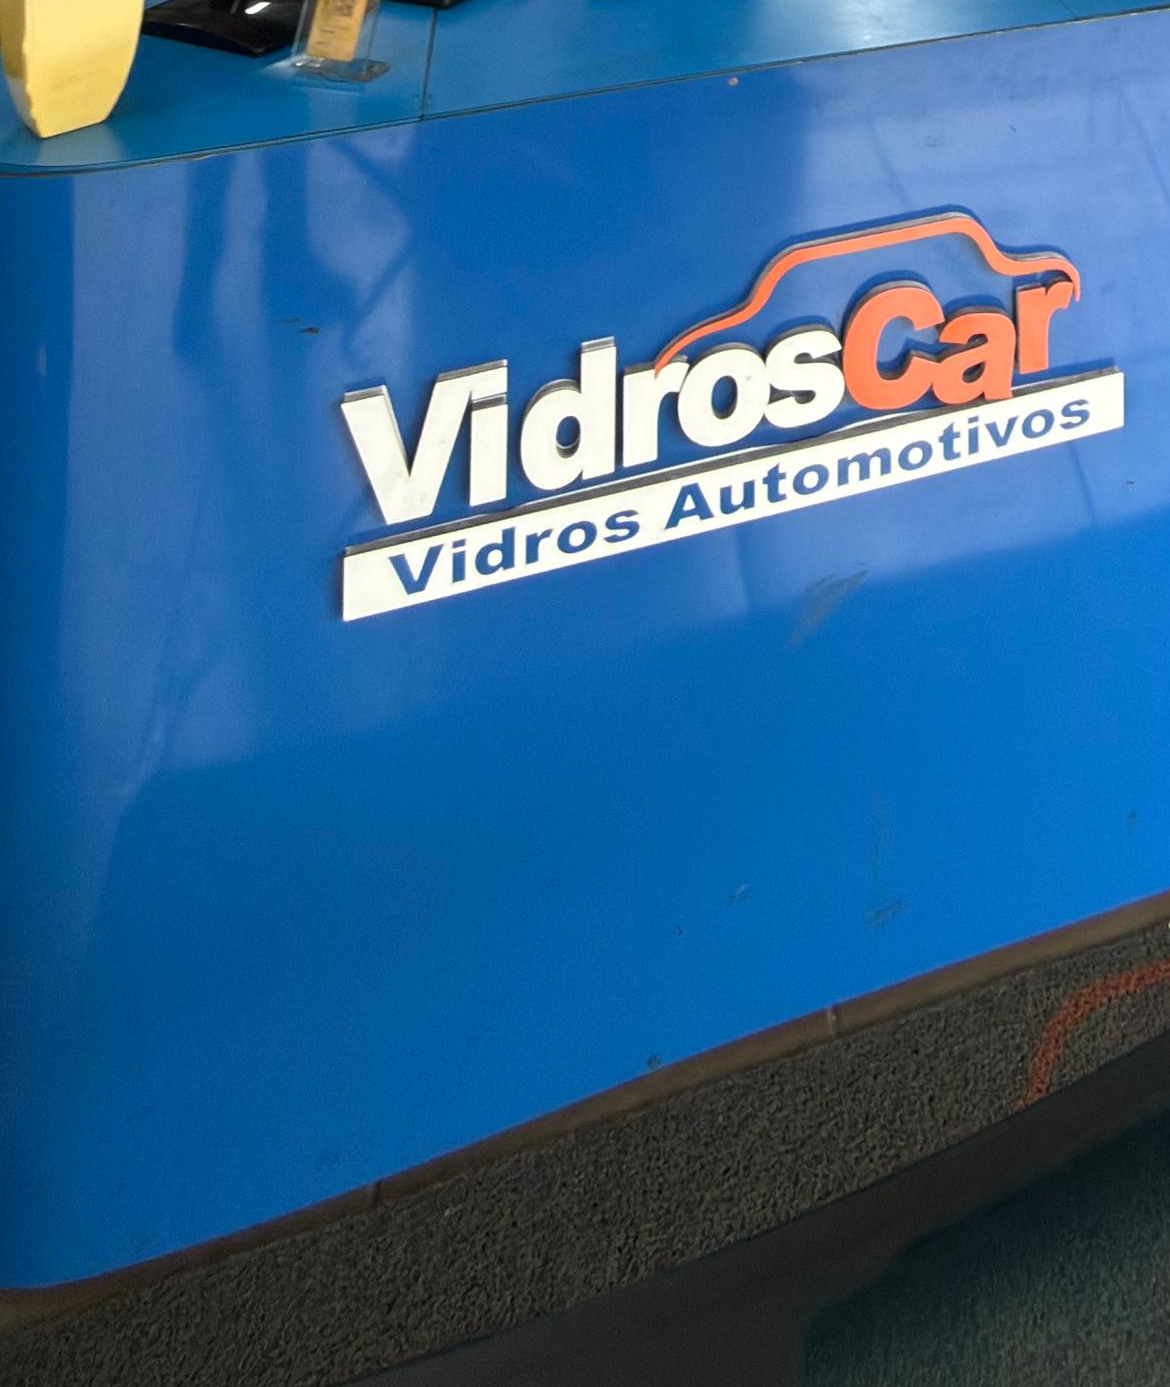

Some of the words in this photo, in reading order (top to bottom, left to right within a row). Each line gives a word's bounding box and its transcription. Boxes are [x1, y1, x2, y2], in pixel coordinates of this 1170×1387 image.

[340, 275, 1074, 525] VidrosCar
[388, 509, 641, 595] Vidros
[664, 398, 1091, 530] Automotivos
